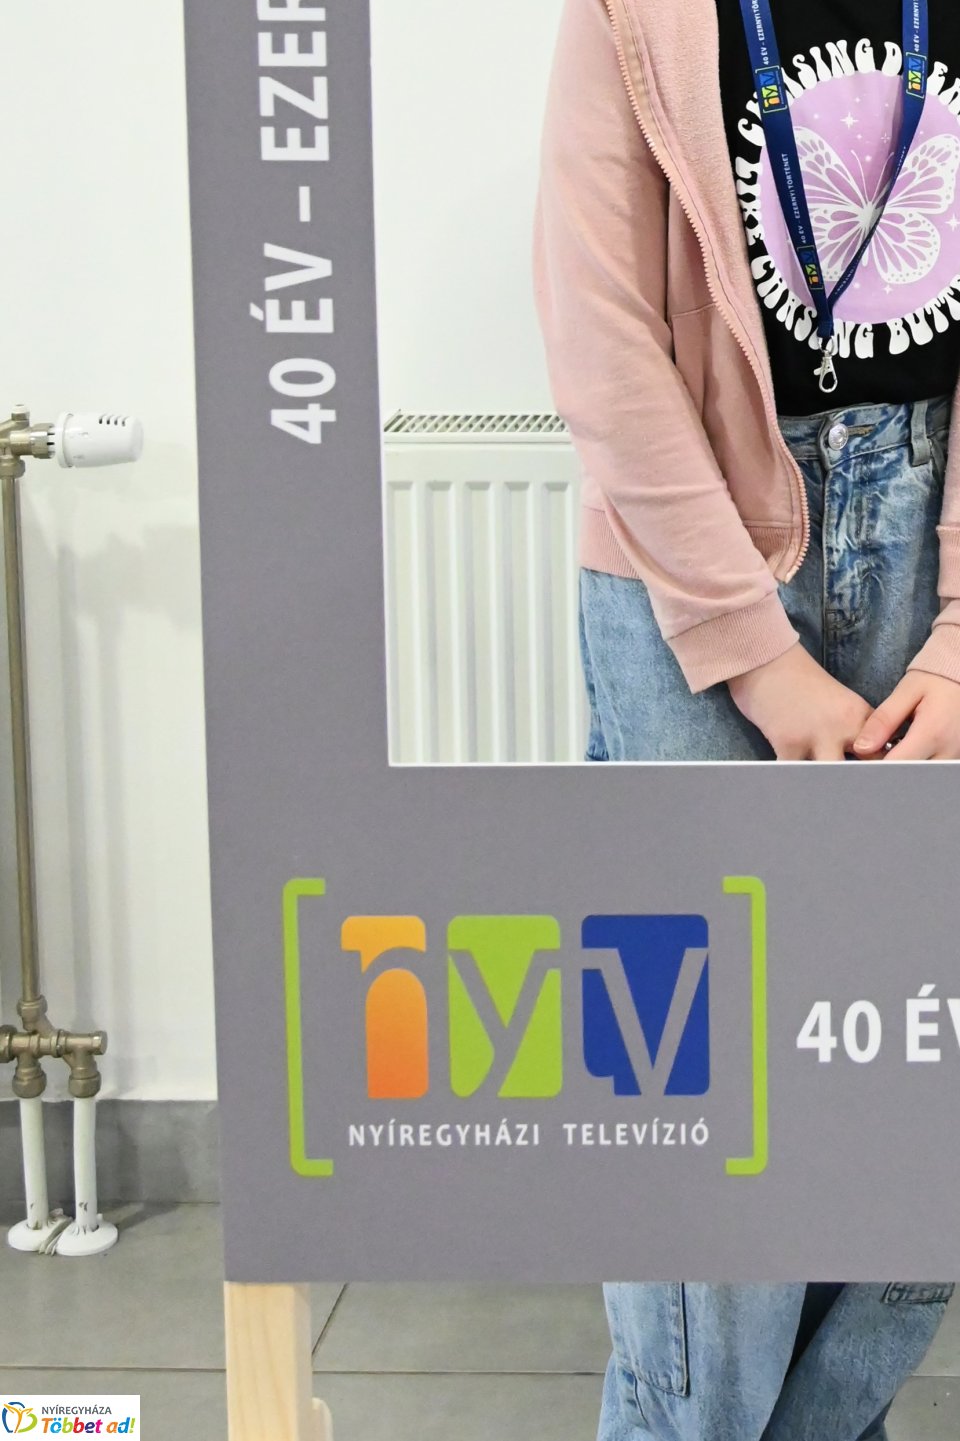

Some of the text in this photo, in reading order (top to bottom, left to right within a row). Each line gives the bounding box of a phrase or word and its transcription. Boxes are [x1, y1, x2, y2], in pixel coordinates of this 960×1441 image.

[755, 12, 766, 41] EZERNYI
[912, 1, 920, 29] EZERNYI
[789, 189, 801, 219] EZERNYI
[250, 243, 334, 334] ÉV
[269, 358, 336, 444] 40
[797, 1000, 881, 1063] 40
[348, 1116, 710, 1147] NYÍREGYHÁZI TELEVÍZIÓ
